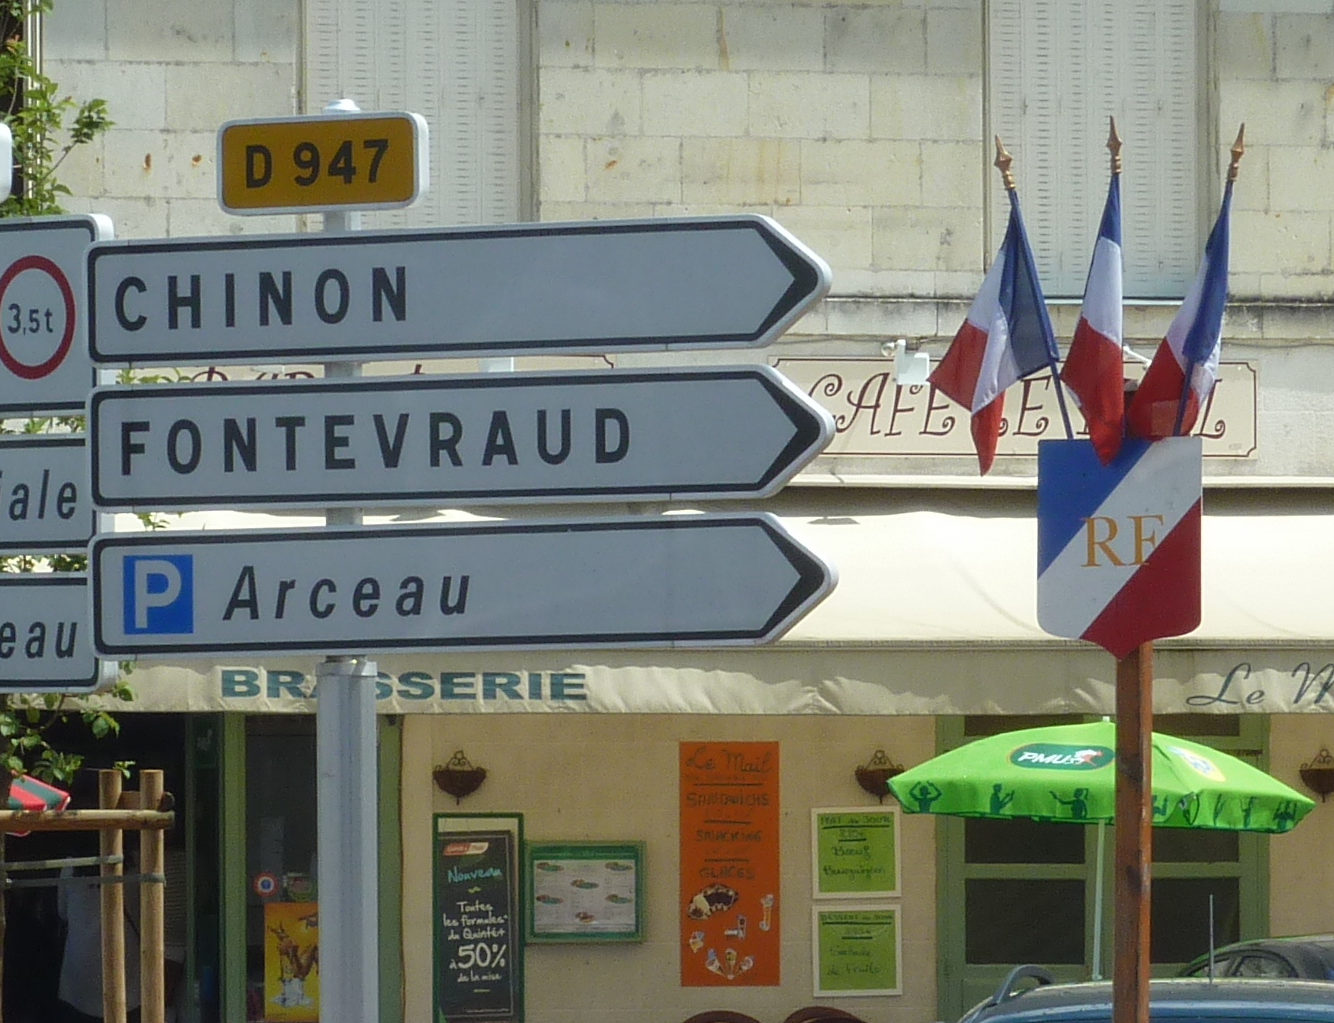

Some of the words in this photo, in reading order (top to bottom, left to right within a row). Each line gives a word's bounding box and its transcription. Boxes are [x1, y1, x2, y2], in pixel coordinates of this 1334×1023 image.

[246, 144, 271, 188] D
[292, 139, 389, 186] 947
[115, 266, 408, 331] CHINON
[121, 408, 630, 476] FONTEVRAUD
[1079, 515, 1164, 568] RF
[134, 559, 181, 629] P
[222, 565, 470, 621] Arceau
[221, 669, 587, 701] BRSSERIE
[1186, 662, 1265, 706] Le
[1018, 752, 1069, 764] PMU
[448, 866, 502, 883] Nouveau
[443, 913, 459, 927] les
[456, 900, 493, 912] Toutes
[448, 929, 460, 940] du
[458, 943, 507, 969] 50%
[457, 971, 468, 982] de
[471, 970, 479, 981] la
[482, 971, 501, 981] mise
